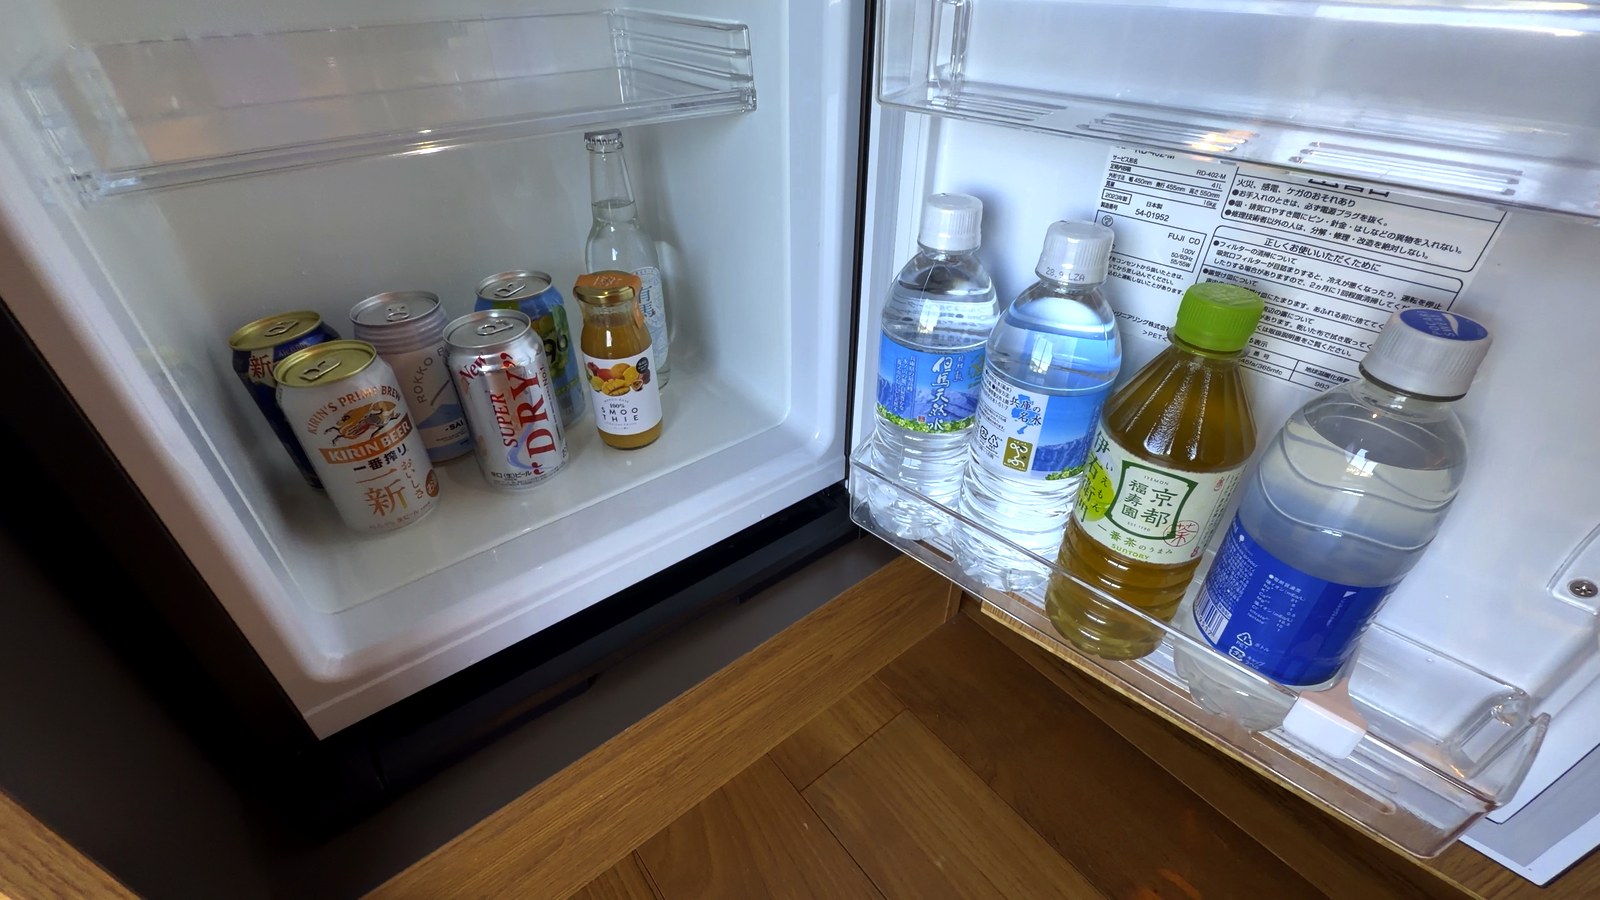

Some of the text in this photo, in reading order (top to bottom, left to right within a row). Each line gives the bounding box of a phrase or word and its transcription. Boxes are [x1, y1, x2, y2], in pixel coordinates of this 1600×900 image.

[1196, 169, 1227, 180] RD-402-M
[1146, 201, 1163, 210] 日本製
[1200, 190, 1221, 199] 550mm
[1135, 209, 1170, 222] 54-01952
[1168, 232, 1185, 242] FUJI
[1264, 237, 1381, 272] 正しくお使いいただくために
[250, 354, 275, 379] 新
[413, 357, 433, 404] ROKKO
[459, 351, 488, 381] New
[927, 356, 953, 431] 但馬天然水
[308, 402, 338, 435] KIRIN'S
[490, 392, 519, 448] SUPER
[602, 413, 638, 422] THIE
[1019, 411, 1042, 426] 名水
[328, 441, 380, 462] KIRIN
[381, 421, 410, 447] BEER
[353, 444, 409, 472] 一番搾り
[1121, 479, 1149, 519] 福寿園
[1140, 488, 1178, 528] 京都
[1097, 523, 1173, 555] 一番茶のうまみ
[1111, 543, 1149, 561] SUNTORY
